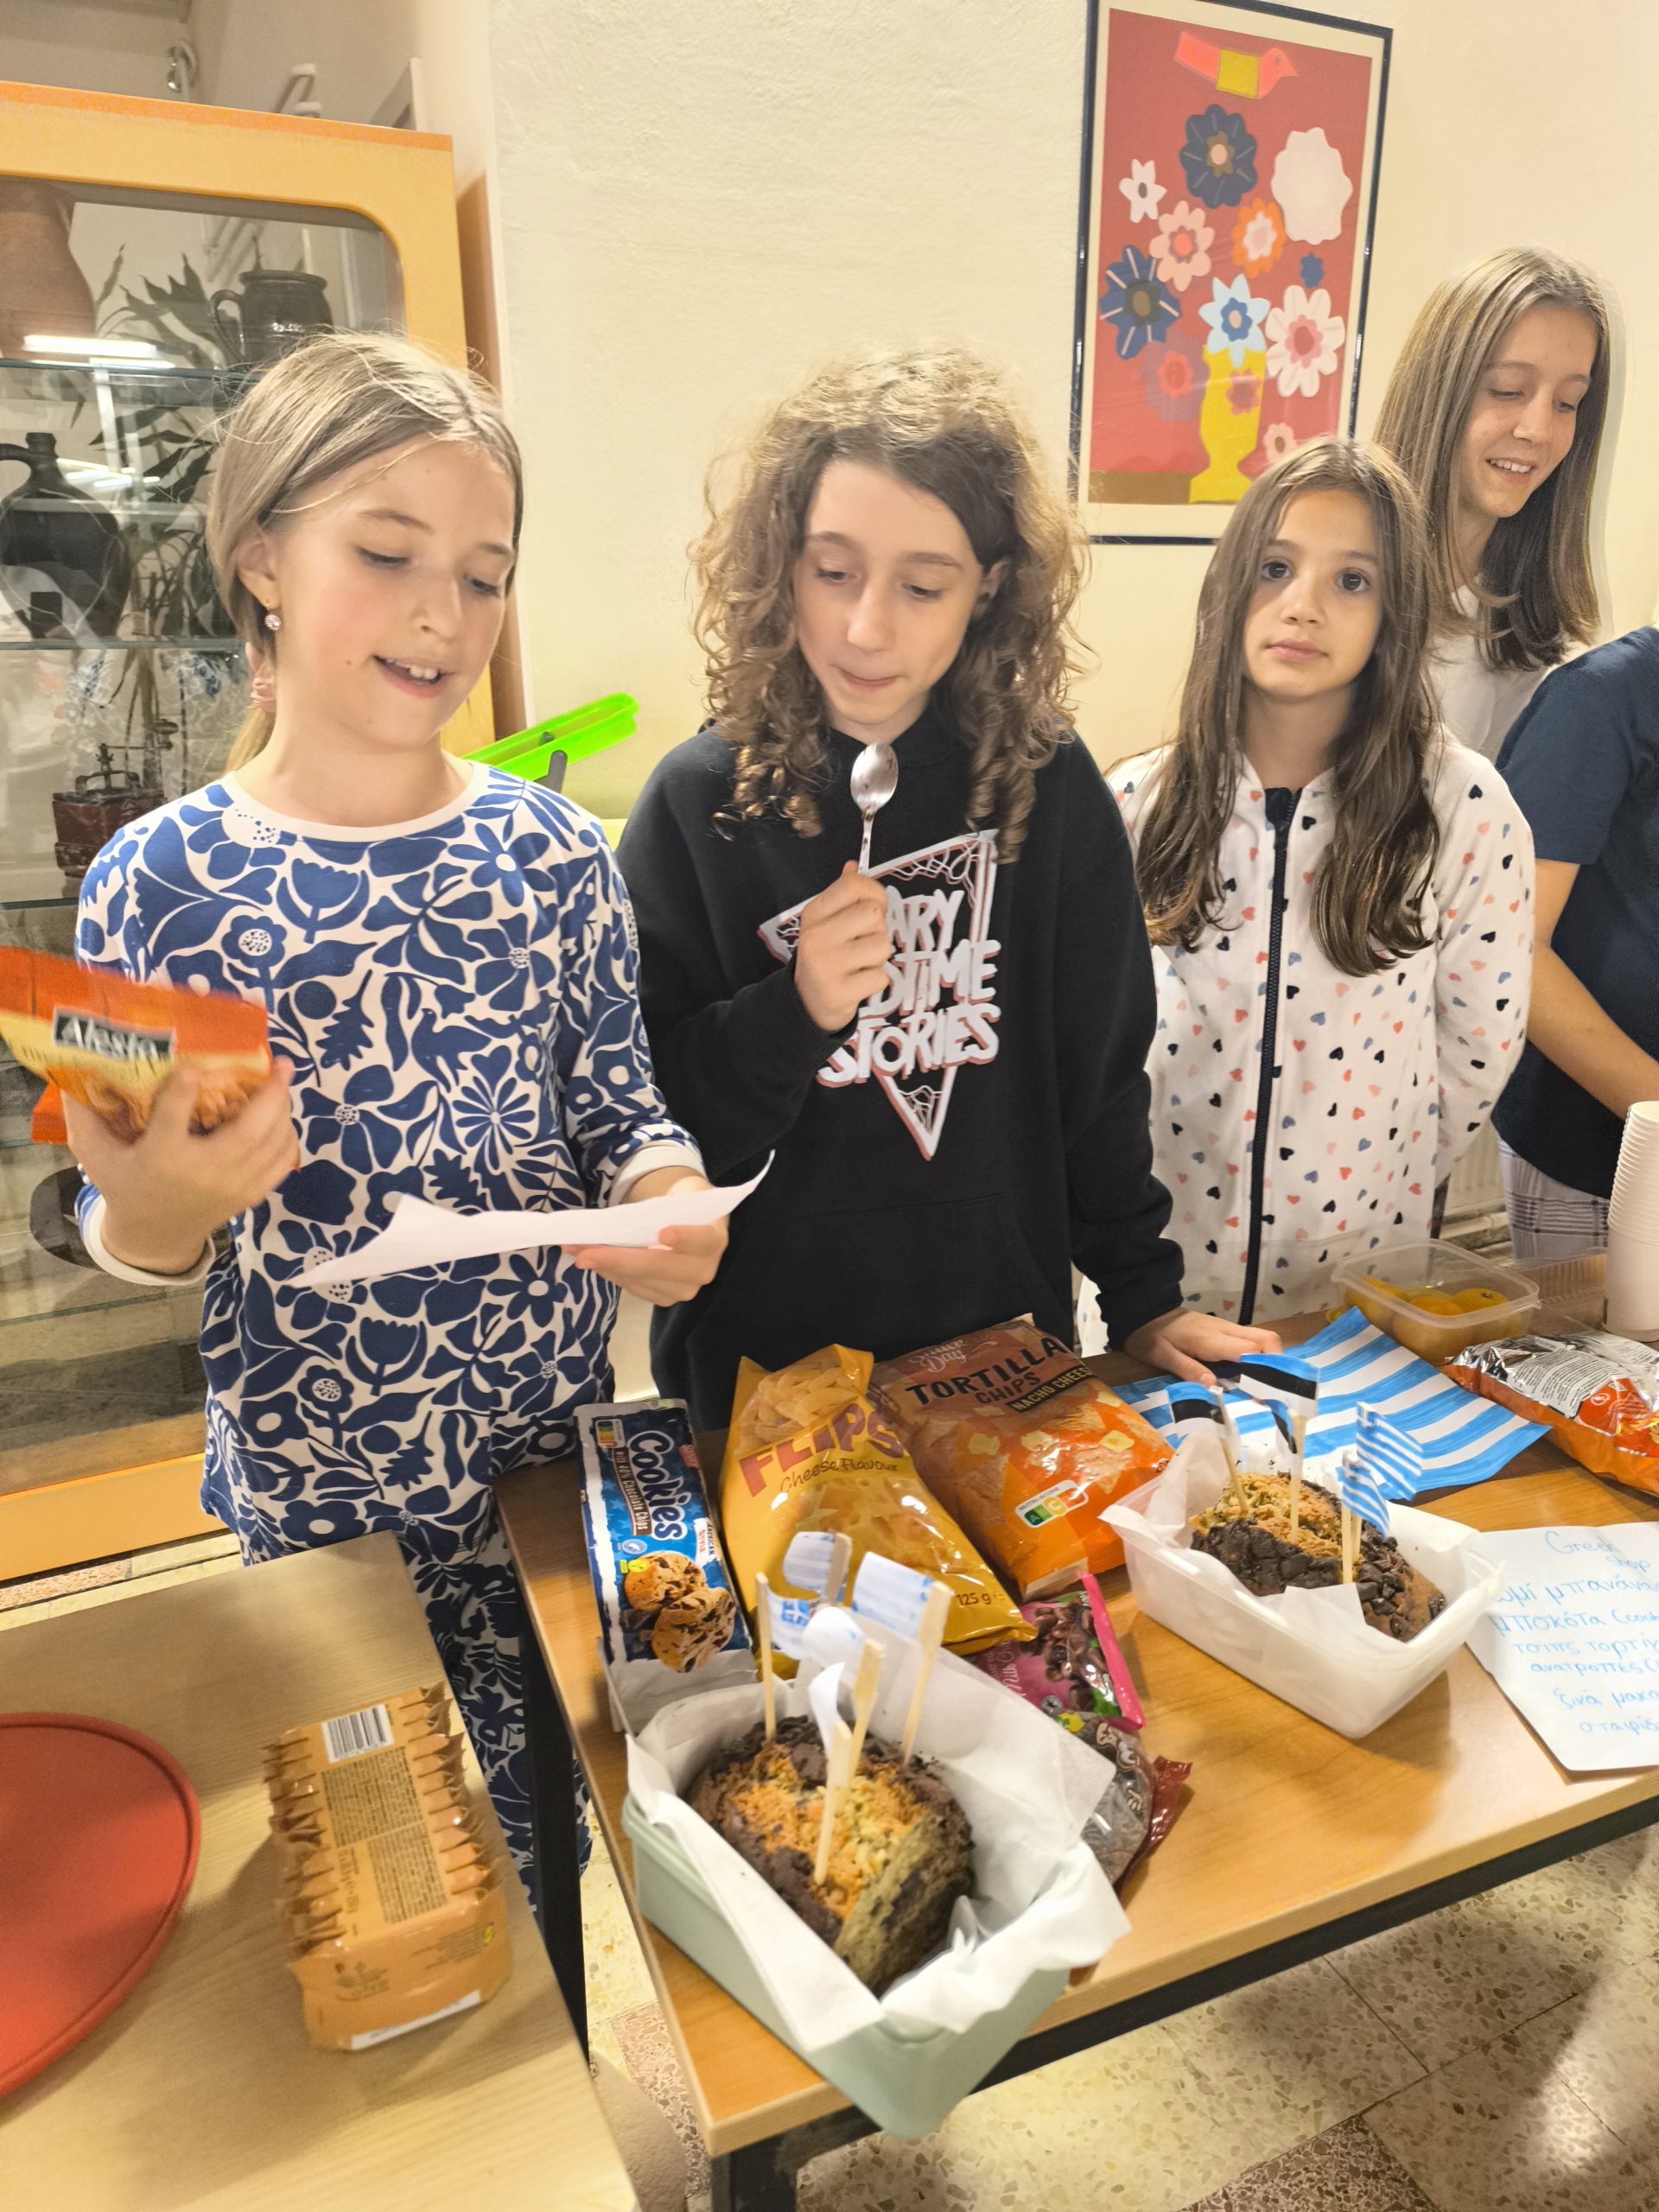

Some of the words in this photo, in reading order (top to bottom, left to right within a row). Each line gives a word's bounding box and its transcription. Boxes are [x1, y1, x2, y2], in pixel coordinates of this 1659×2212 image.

[860, 938, 1001, 1018] DTIME
[906, 1338, 1068, 1405] TORTILLA
[975, 1371, 1041, 1404] CHIPS
[1012, 1384, 1056, 1411] NACHO
[740, 1402, 905, 1497] FLIPS
[614, 1451, 629, 1465] with
[625, 1479, 645, 1512] Chocolate
[635, 1512, 648, 1530] Chips
[627, 1430, 691, 1541] Cookies
[780, 1460, 838, 1494] Cheese
[841, 1458, 898, 1471] Flavour
[1545, 1530, 1622, 1554] Greek
[955, 1592, 979, 1606] 125
[982, 1592, 992, 1605] g
